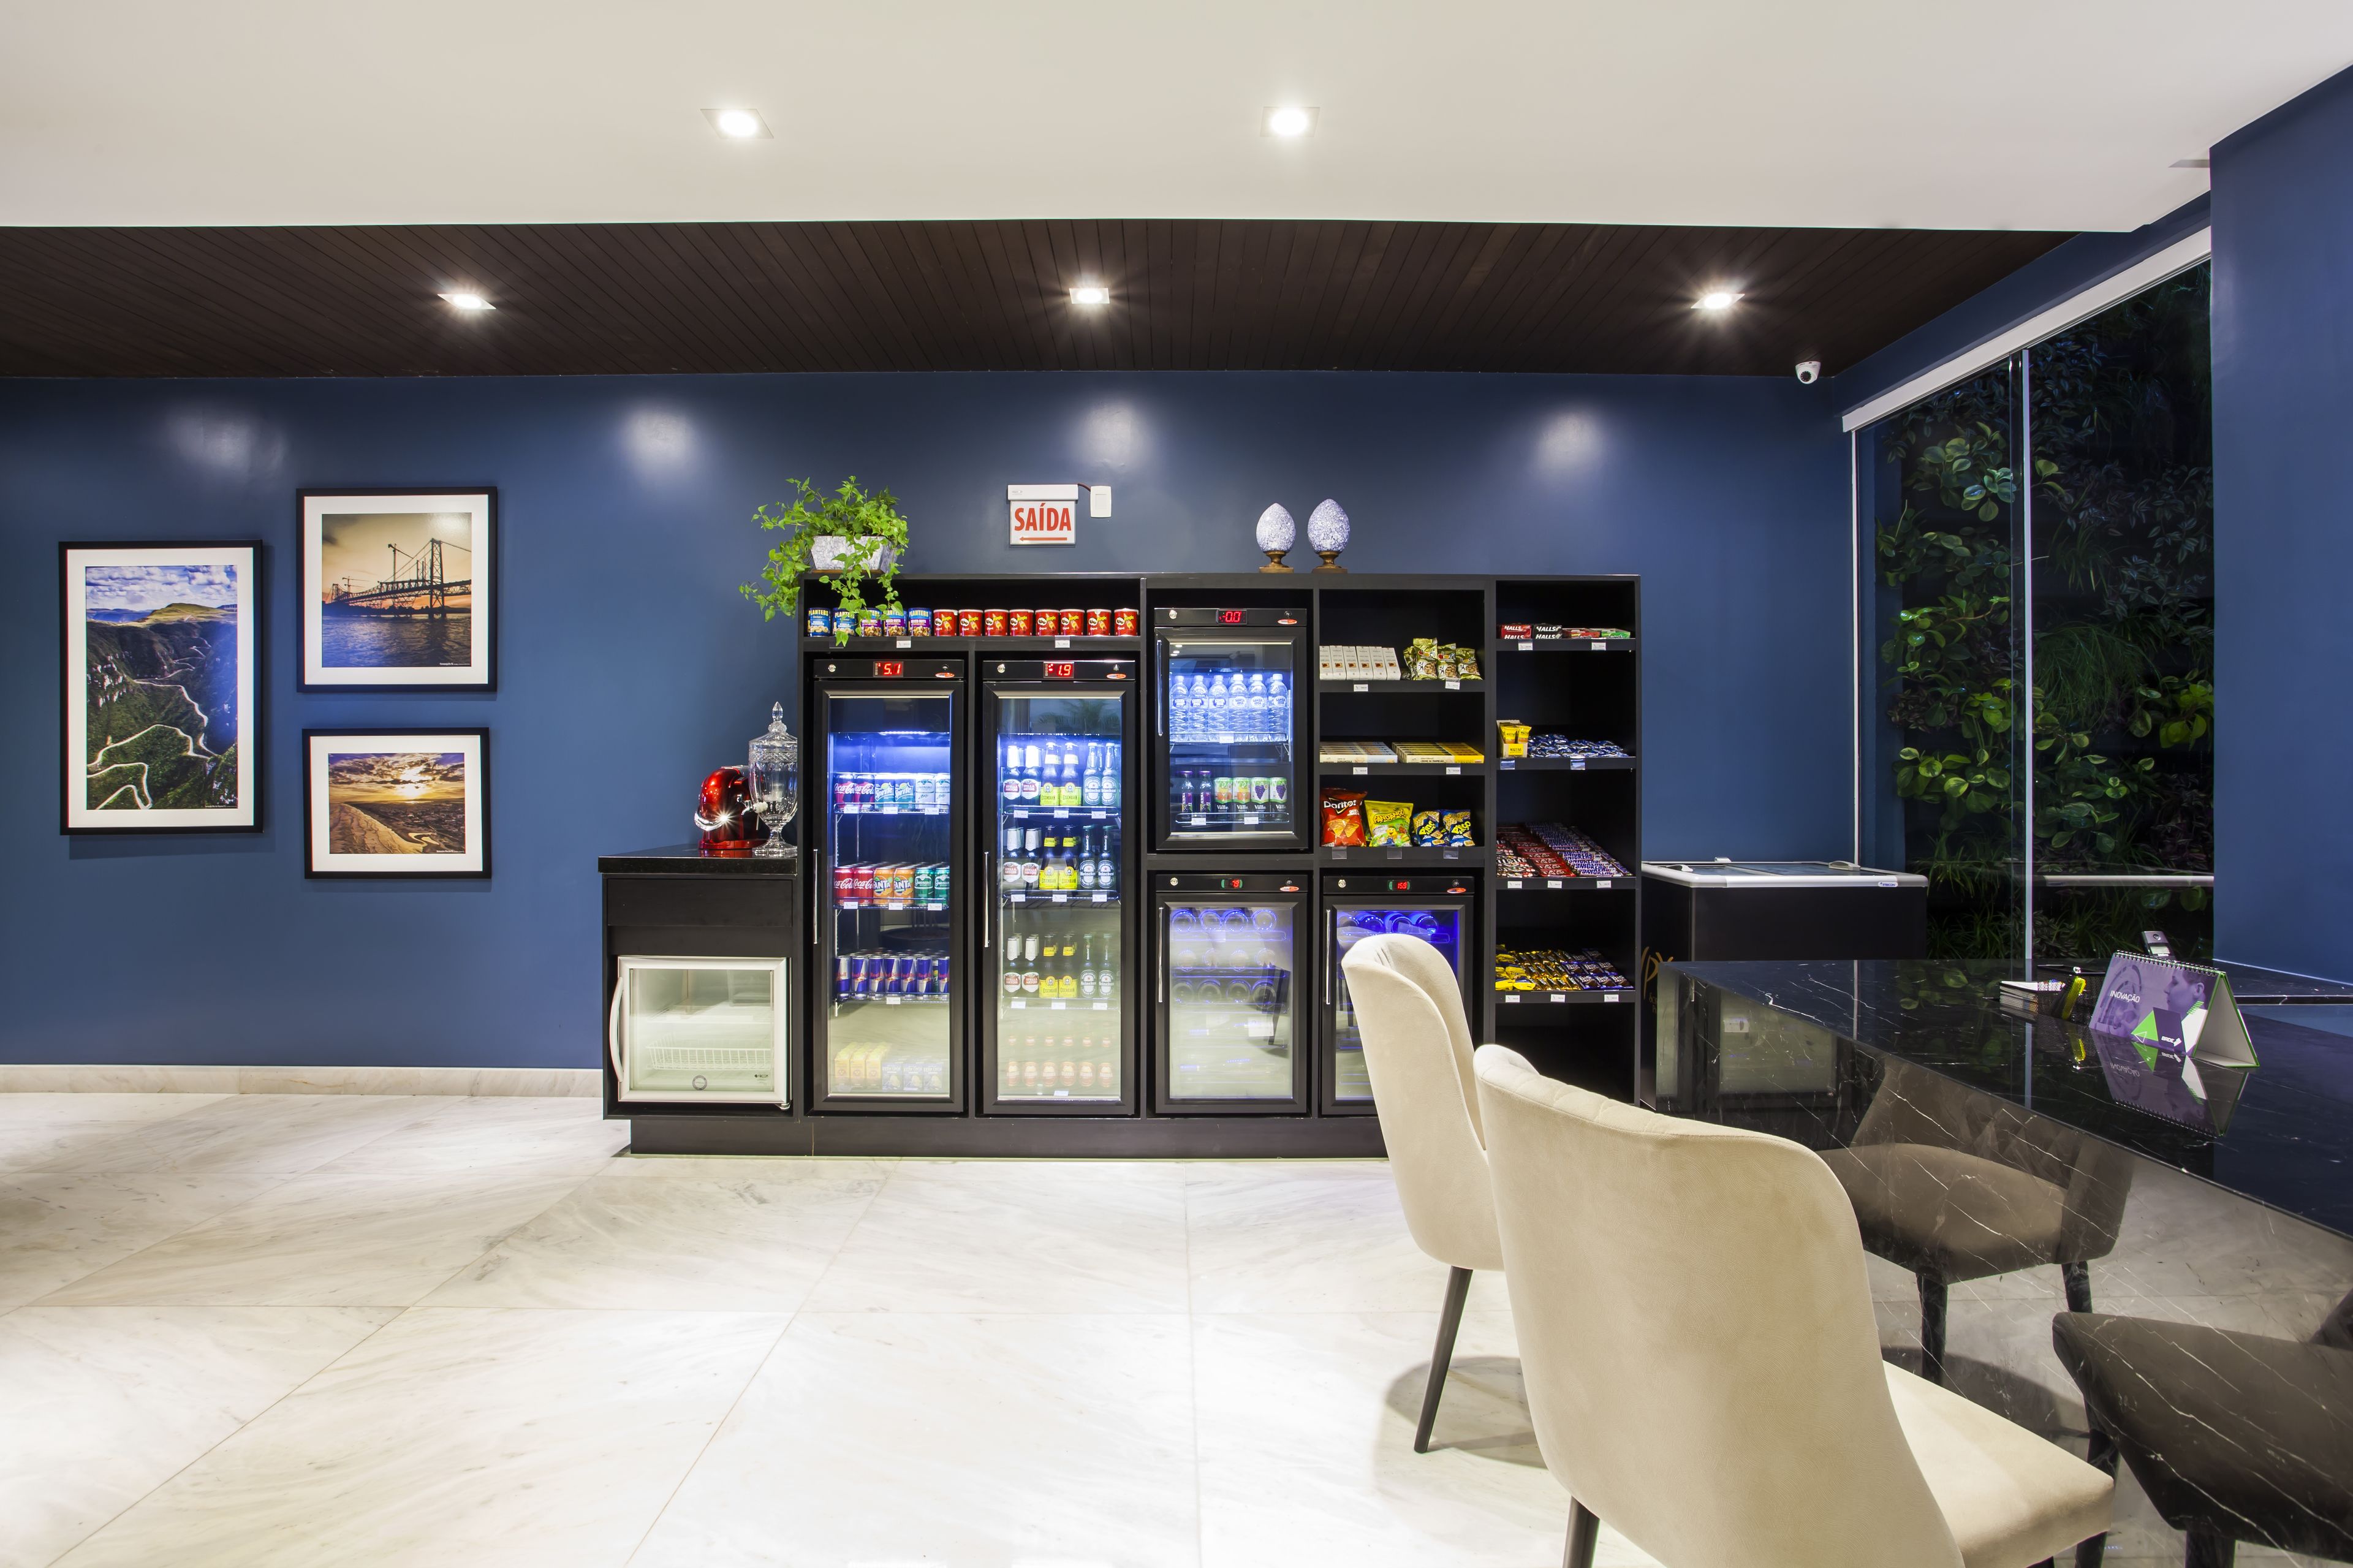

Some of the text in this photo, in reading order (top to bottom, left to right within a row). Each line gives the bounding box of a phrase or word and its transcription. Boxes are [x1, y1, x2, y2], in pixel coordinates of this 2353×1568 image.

[1014, 502, 1071, 531] SAÍDA
[833, 878, 854, 889] ca-Cola
[854, 878, 873, 889] Coca-Co
[2110, 990, 2140, 1003] INOVAÇÃO
